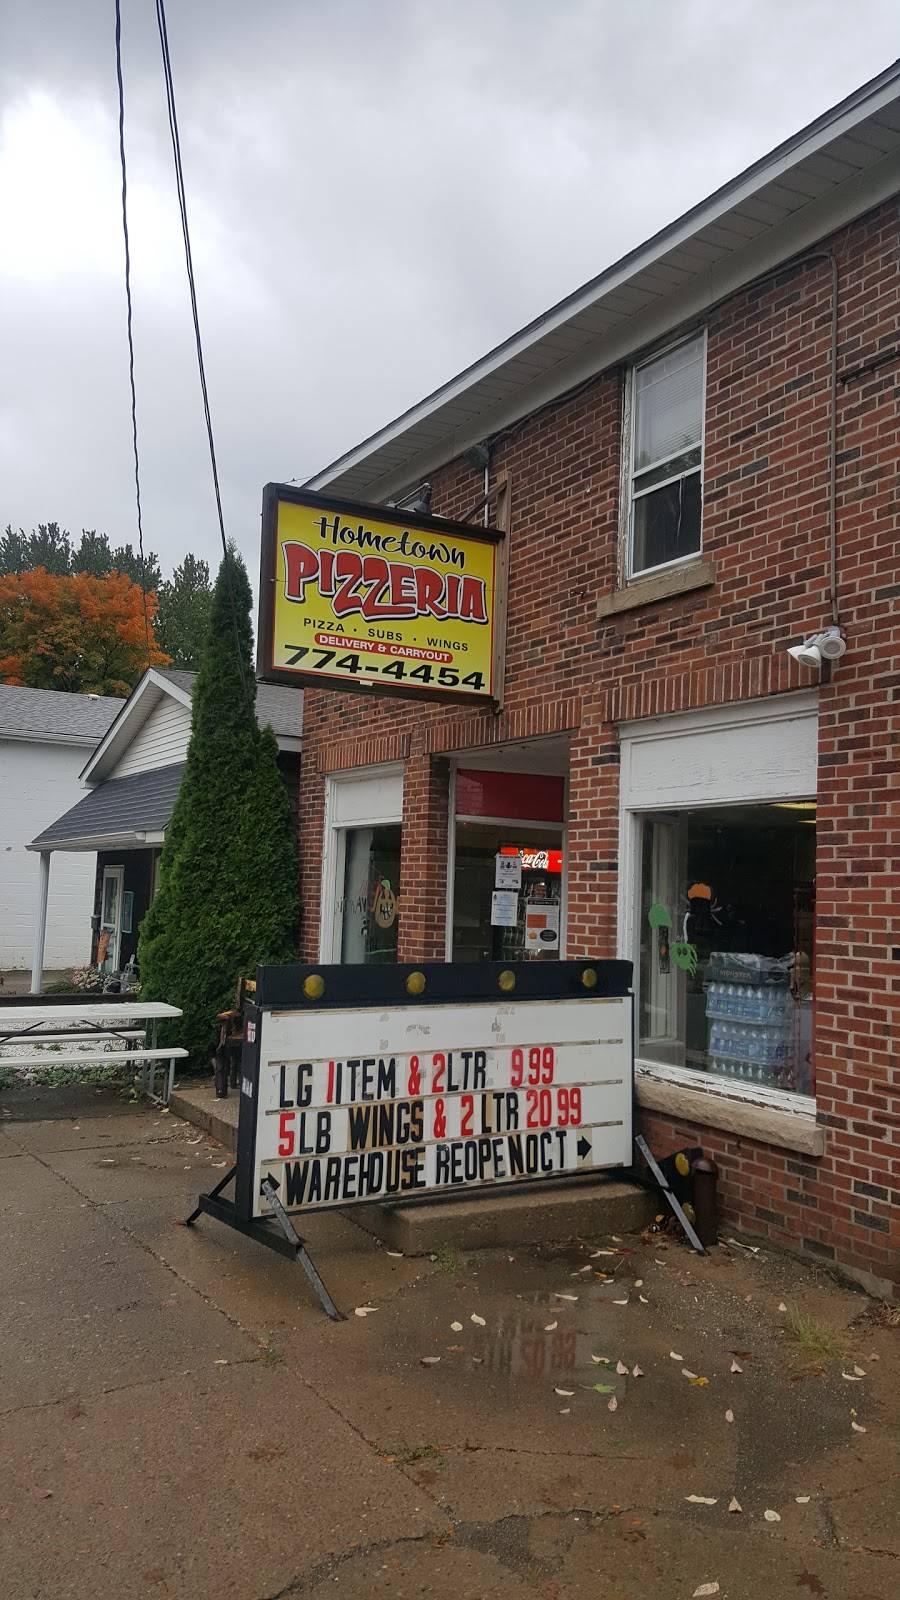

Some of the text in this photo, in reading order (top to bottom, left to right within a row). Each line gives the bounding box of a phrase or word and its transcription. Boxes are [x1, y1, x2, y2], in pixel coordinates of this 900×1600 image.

[313, 516, 466, 569] Hometown
[281, 540, 488, 625] PIZZERIA
[303, 617, 469, 652] PIZZA SUBS WINGS
[319, 635, 450, 662] DELIVERY & CARRYOUT
[284, 644, 485, 690] 774-4454
[279, 1063, 313, 1108] LG
[408, 1055, 421, 1096] &
[349, 1100, 424, 1150] WINGS
[433, 1098, 447, 1139] &
[460, 1094, 474, 1137] 2
[481, 1091, 519, 1133] LTR
[285, 1146, 426, 1206] WAREHOUSE
